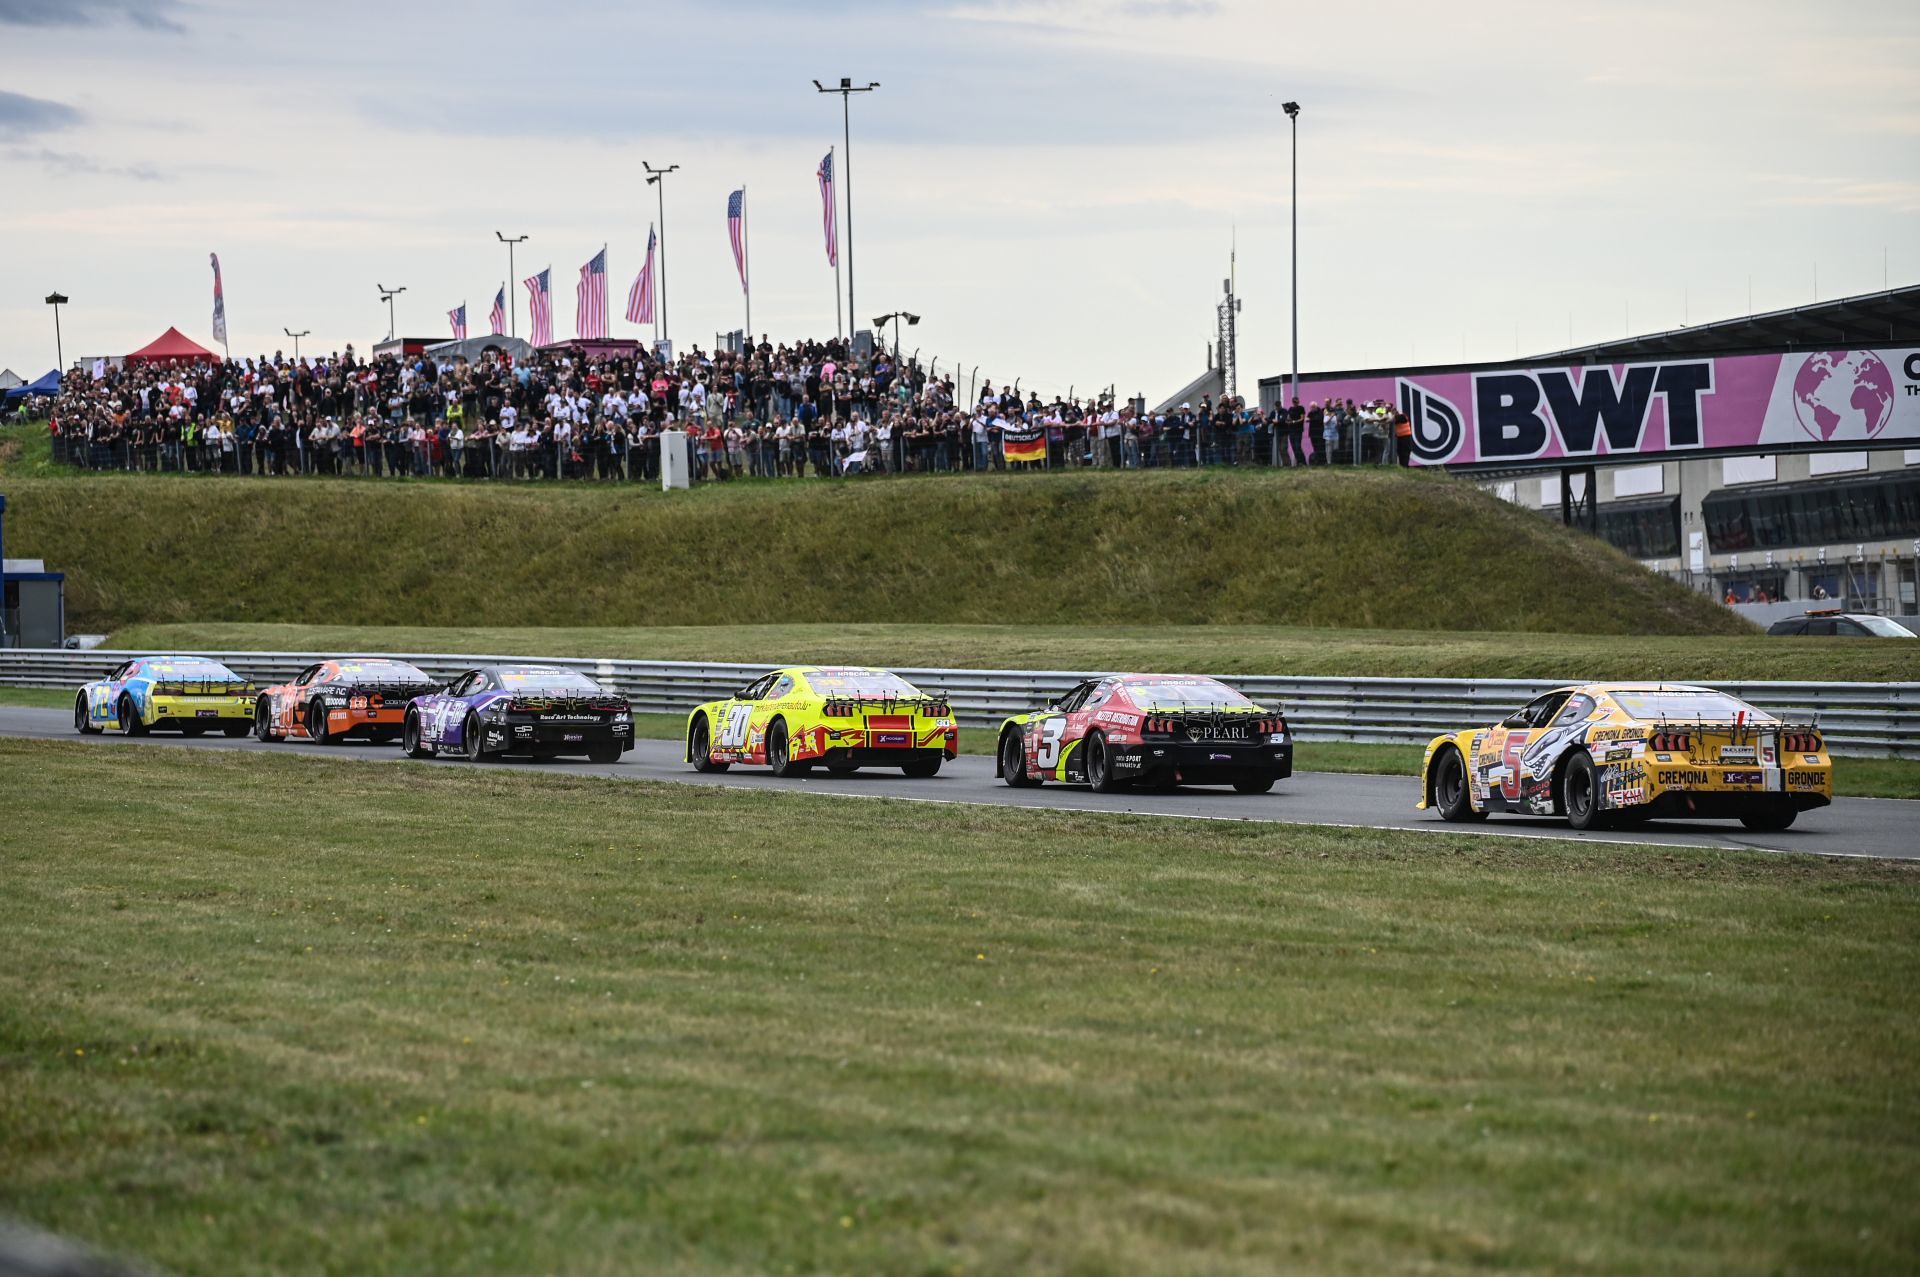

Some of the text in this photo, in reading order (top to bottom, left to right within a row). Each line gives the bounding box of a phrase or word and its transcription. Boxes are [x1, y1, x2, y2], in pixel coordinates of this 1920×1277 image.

[1477, 363, 1711, 457] BWT
[614, 713, 628, 722] 34
[721, 704, 753, 748] 30
[1204, 727, 1249, 739] PEARL
[1037, 718, 1067, 769] 3
[1270, 733, 1285, 744] 3
[1762, 747, 1775, 763] 5
[1499, 730, 1532, 803] 5
[1658, 770, 1709, 785] CREMONA
[1788, 771, 1826, 786] GRONDE
